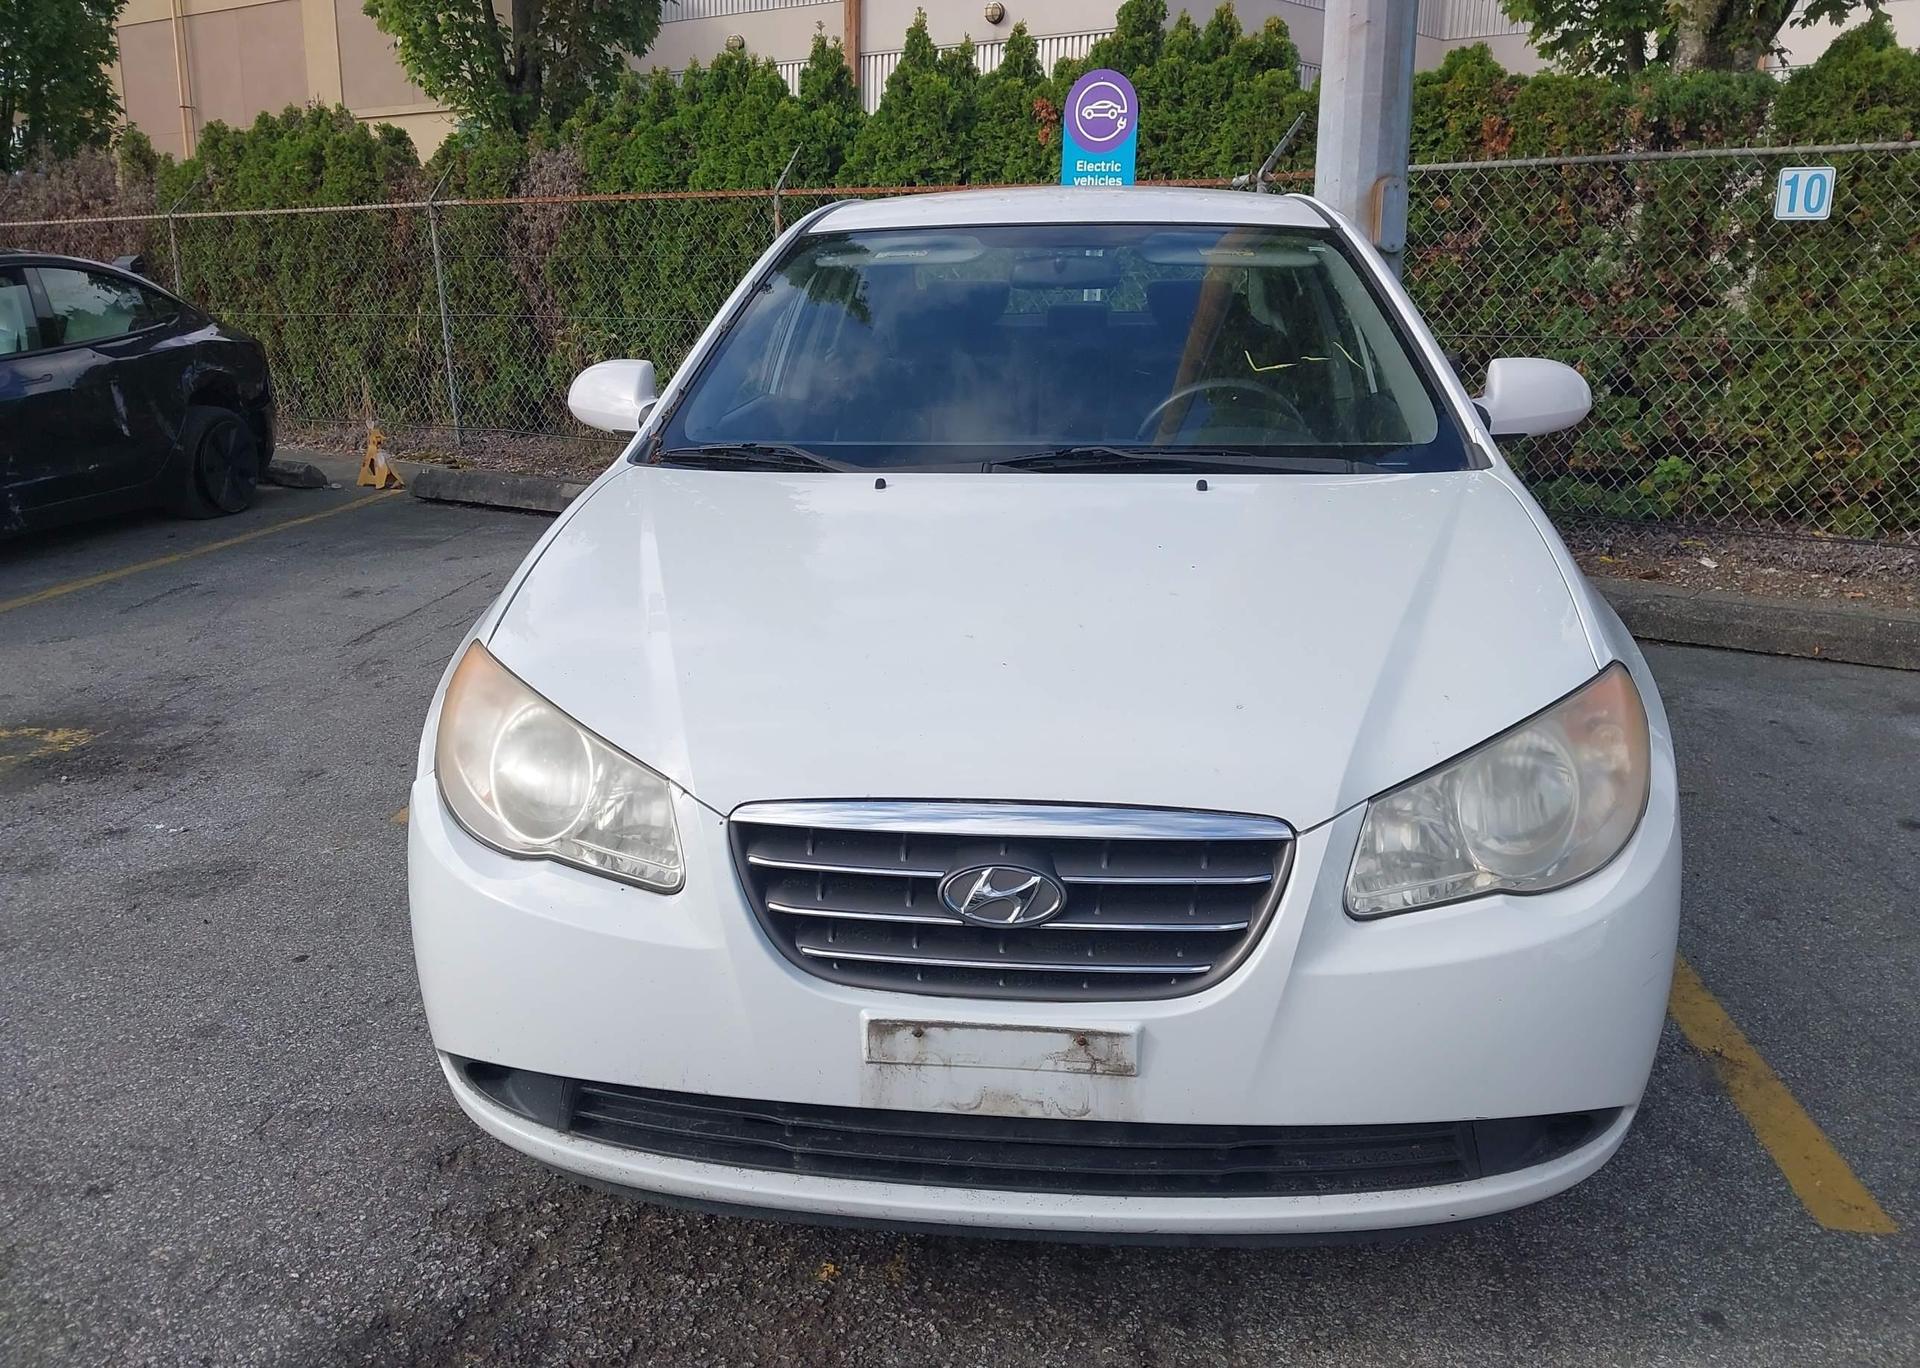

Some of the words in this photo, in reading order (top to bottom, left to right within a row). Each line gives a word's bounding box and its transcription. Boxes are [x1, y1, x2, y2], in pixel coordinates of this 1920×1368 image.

[1076, 160, 1121, 172] Electric
[1073, 174, 1122, 186] vehicles
[1784, 173, 1827, 214] 10
